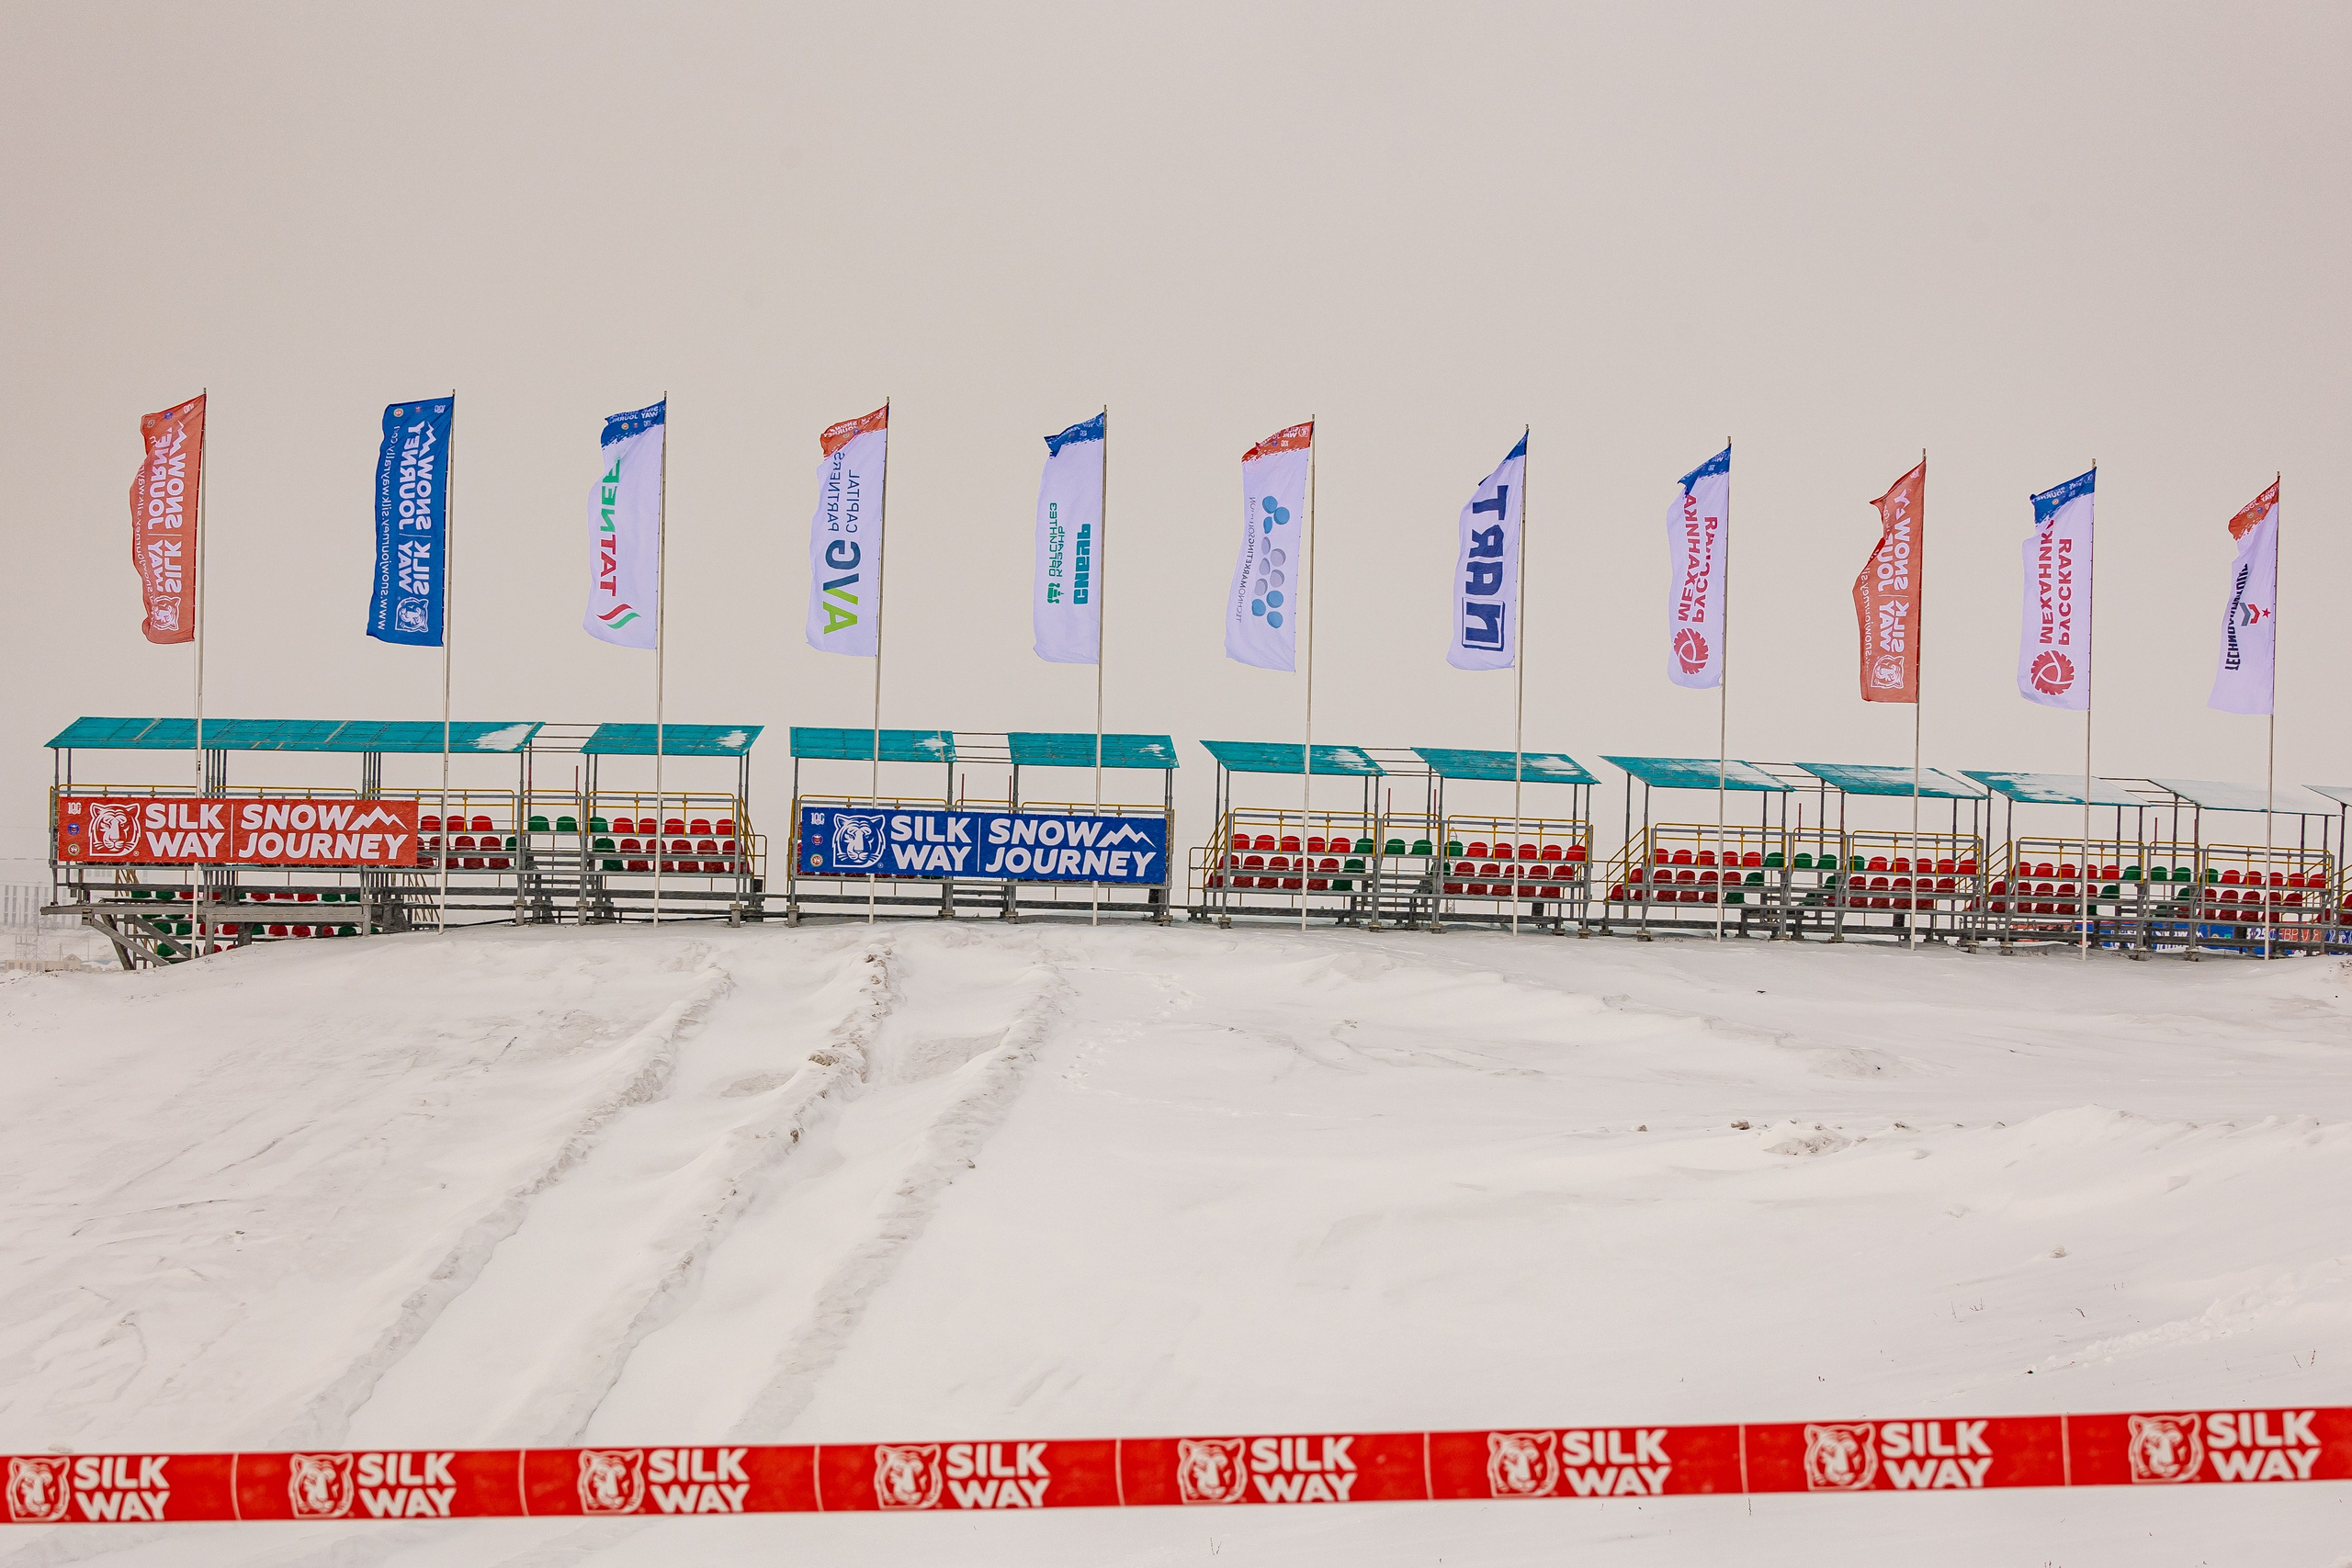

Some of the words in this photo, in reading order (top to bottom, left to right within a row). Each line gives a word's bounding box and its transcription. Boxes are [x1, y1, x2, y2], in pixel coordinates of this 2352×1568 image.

[144, 804, 224, 829] SILK
[241, 804, 356, 831] SNOW
[890, 816, 973, 842] SILK
[145, 832, 224, 857] WAY
[238, 833, 409, 860] JOURNEY
[988, 818, 1103, 847] SNOW
[891, 844, 972, 872] WAY
[985, 847, 1157, 876] JOURNEY
[1882, 1421, 1989, 1458] SILK
[2207, 1412, 2320, 1447] SILK
[946, 1443, 1047, 1477] SILK
[1251, 1438, 1356, 1472] SILK
[1563, 1429, 1670, 1463] SILK
[75, 1457, 169, 1490] SILK
[358, 1453, 456, 1486] SILK
[649, 1449, 749, 1483] SILK
[1883, 1458, 1992, 1489] WAY
[2207, 1449, 2320, 1481] WAY
[949, 1477, 1049, 1508] WAY
[1253, 1472, 1357, 1503] WAY
[1565, 1467, 1672, 1496] WAY
[75, 1490, 170, 1521] WAY
[359, 1486, 456, 1517] WAY
[651, 1483, 749, 1514] WAY
